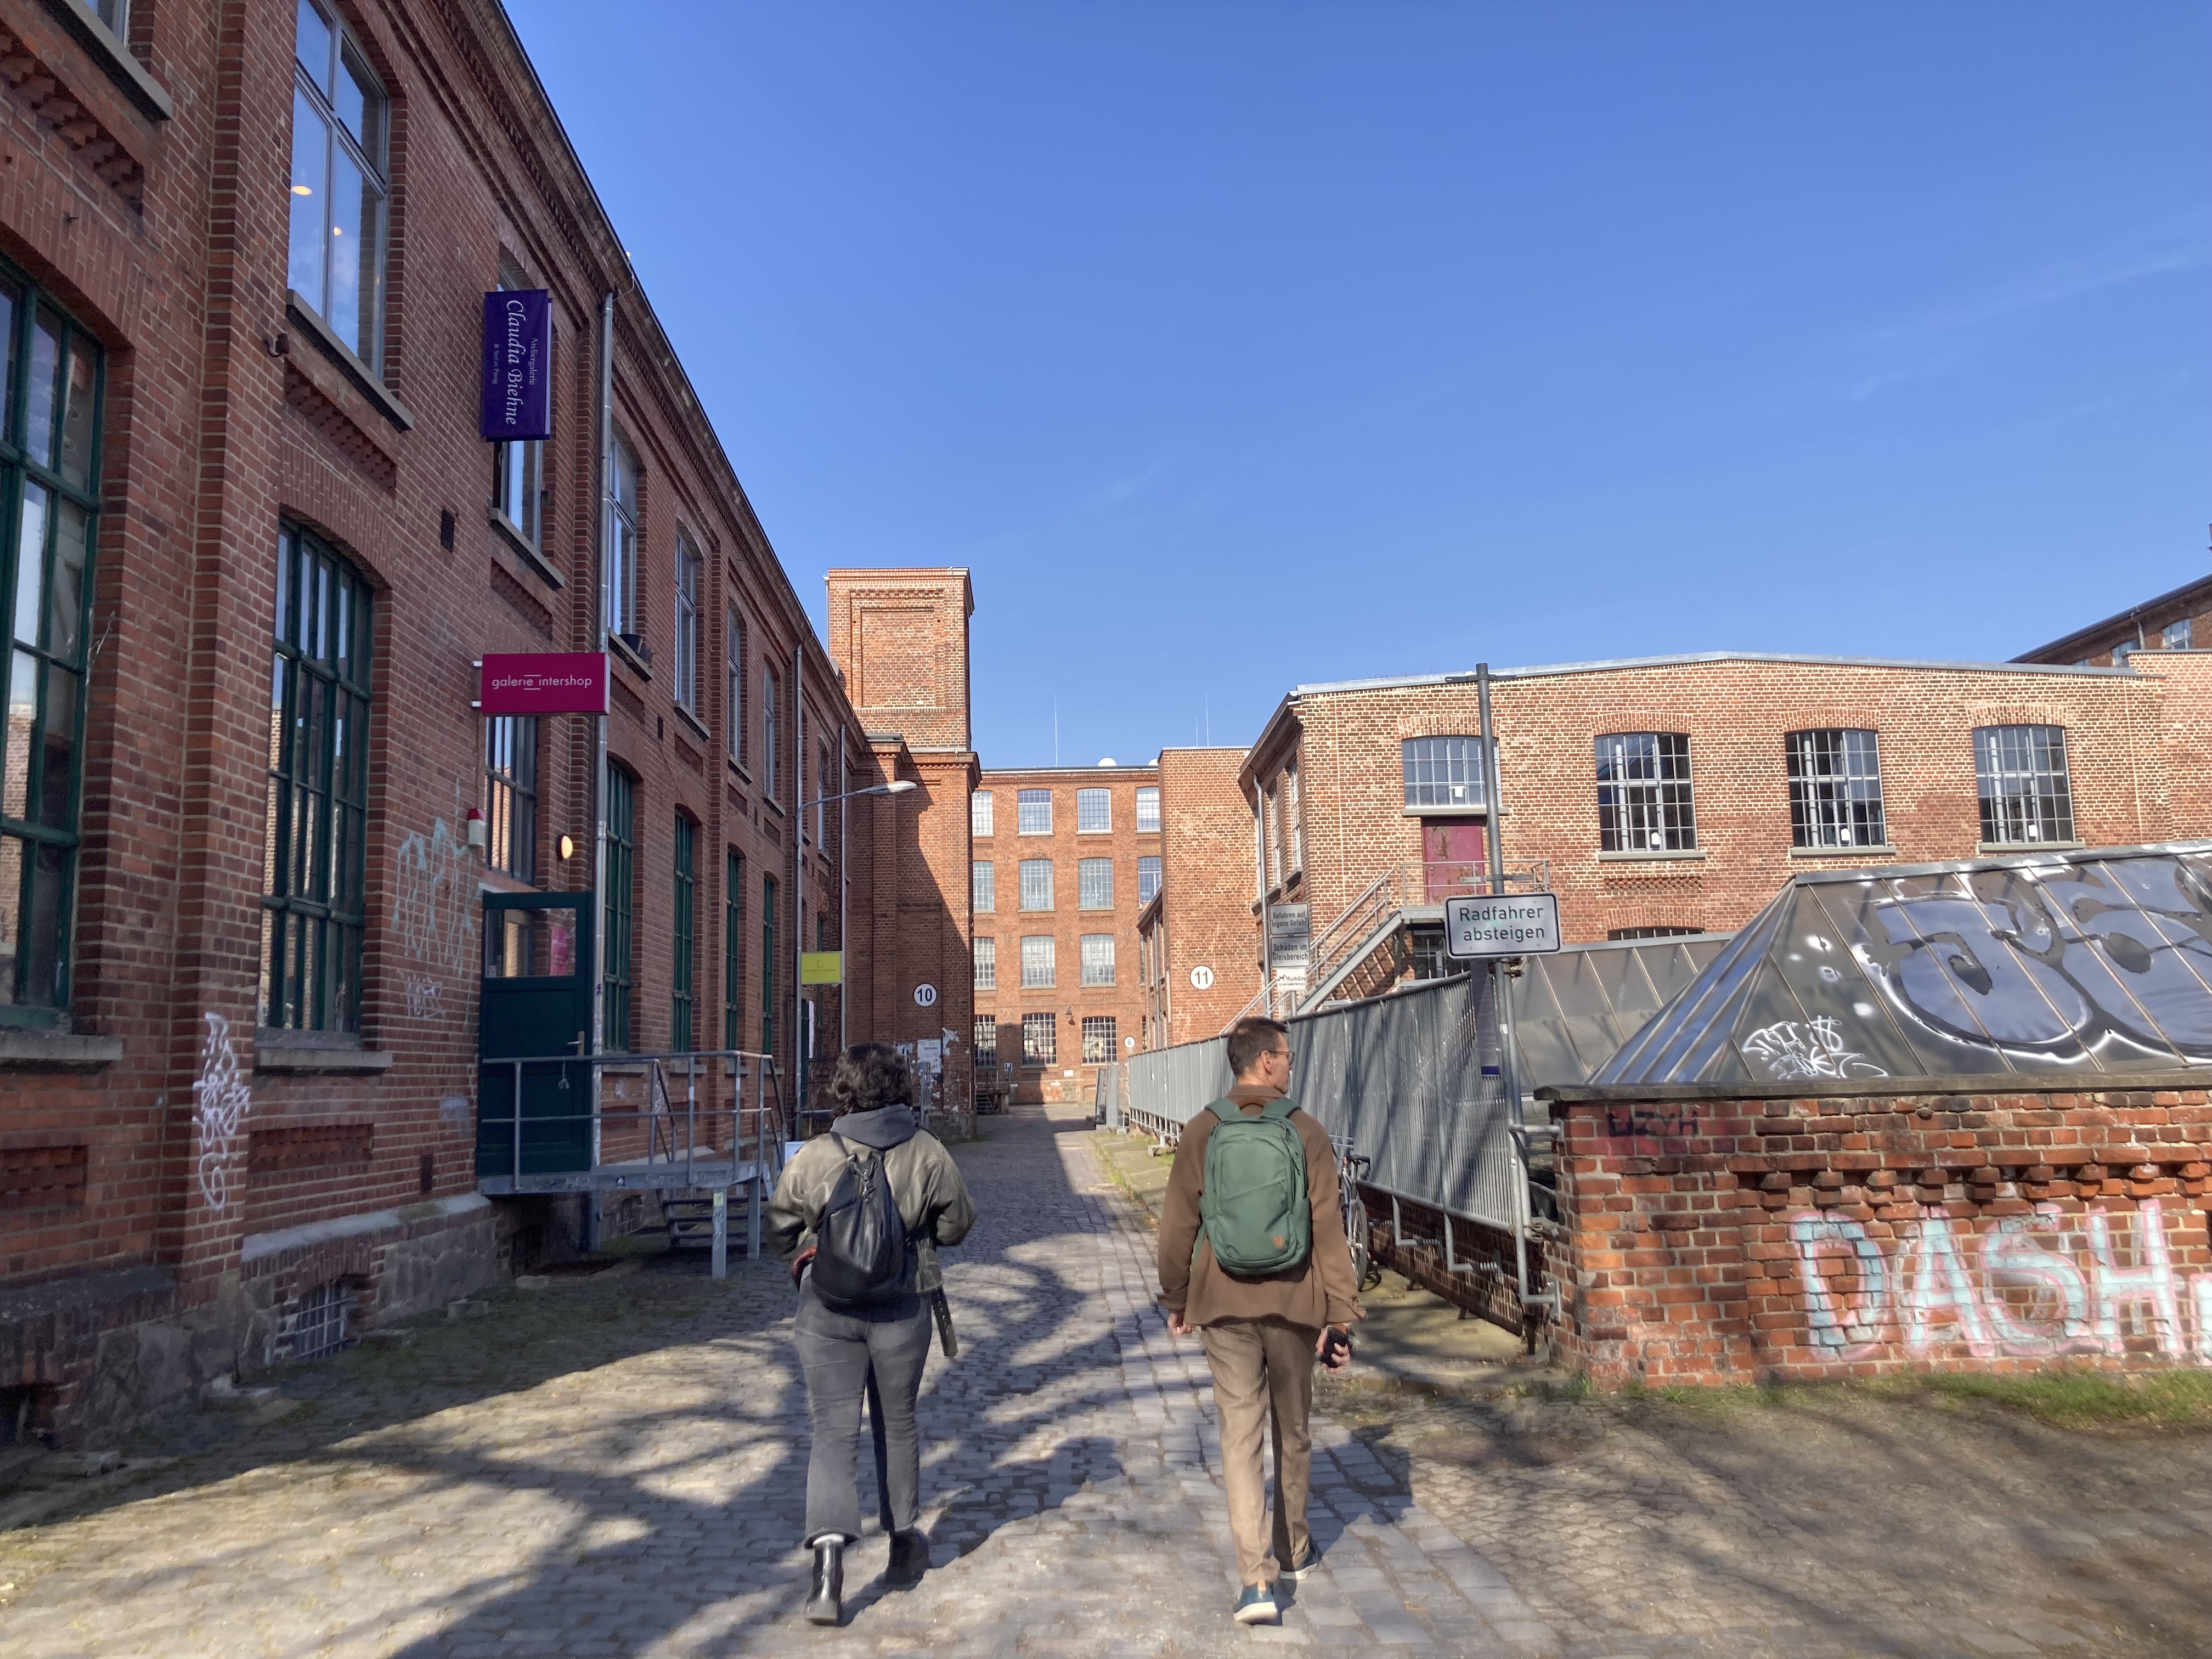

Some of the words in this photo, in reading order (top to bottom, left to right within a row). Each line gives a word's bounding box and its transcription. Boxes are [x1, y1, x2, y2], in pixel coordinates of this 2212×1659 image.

[506, 300, 526, 364] Claudia
[506, 369, 523, 425] Biehne
[492, 675, 533, 689] galerie
[539, 674, 592, 688] intershop
[1459, 906, 1543, 922] Radfahrer
[1463, 926, 1544, 943] absteigen
[1273, 943, 1297, 951] Schäden
[1272, 952, 1308, 961] Gleisbereich
[1194, 970, 1208, 984] 11
[917, 988, 933, 1002] 10
